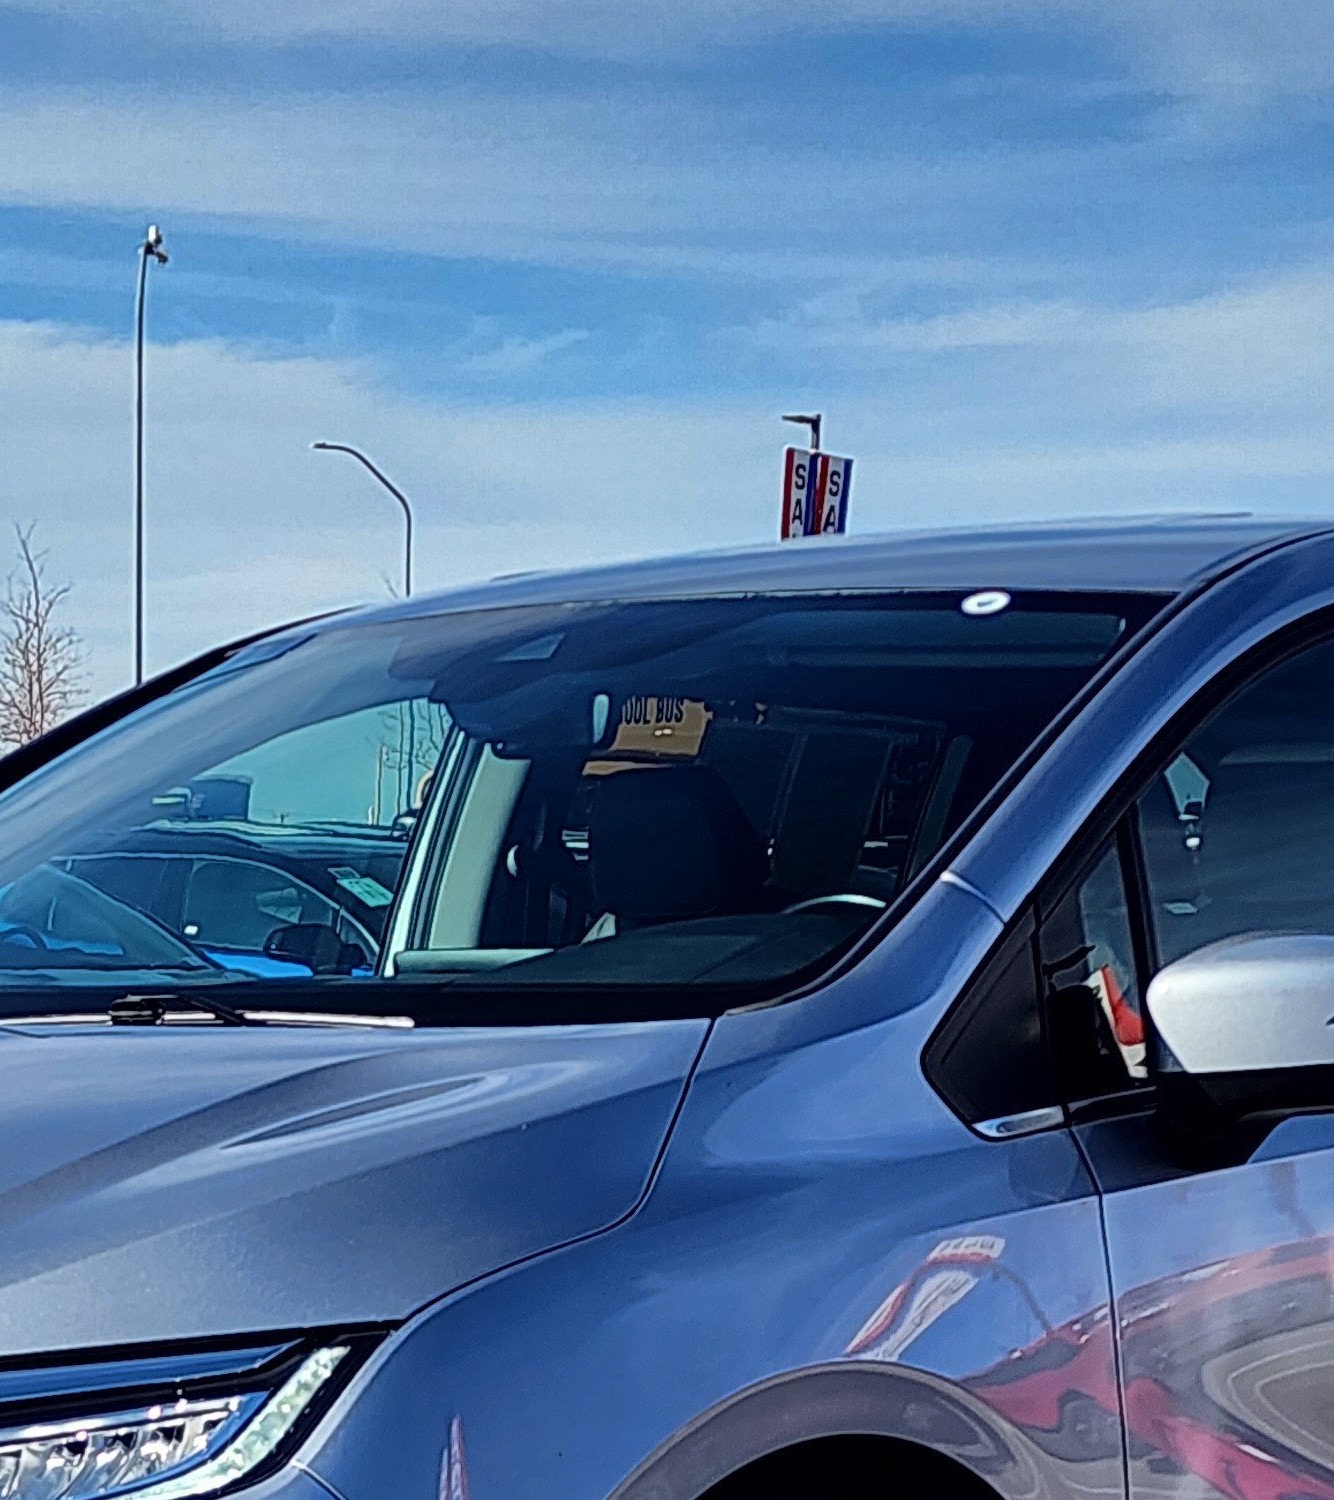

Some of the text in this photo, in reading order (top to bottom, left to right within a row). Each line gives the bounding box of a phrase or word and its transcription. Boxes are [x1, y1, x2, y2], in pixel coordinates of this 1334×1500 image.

[791, 463, 807, 526] SA
[822, 469, 842, 534] SA
[655, 697, 685, 724] BUS
